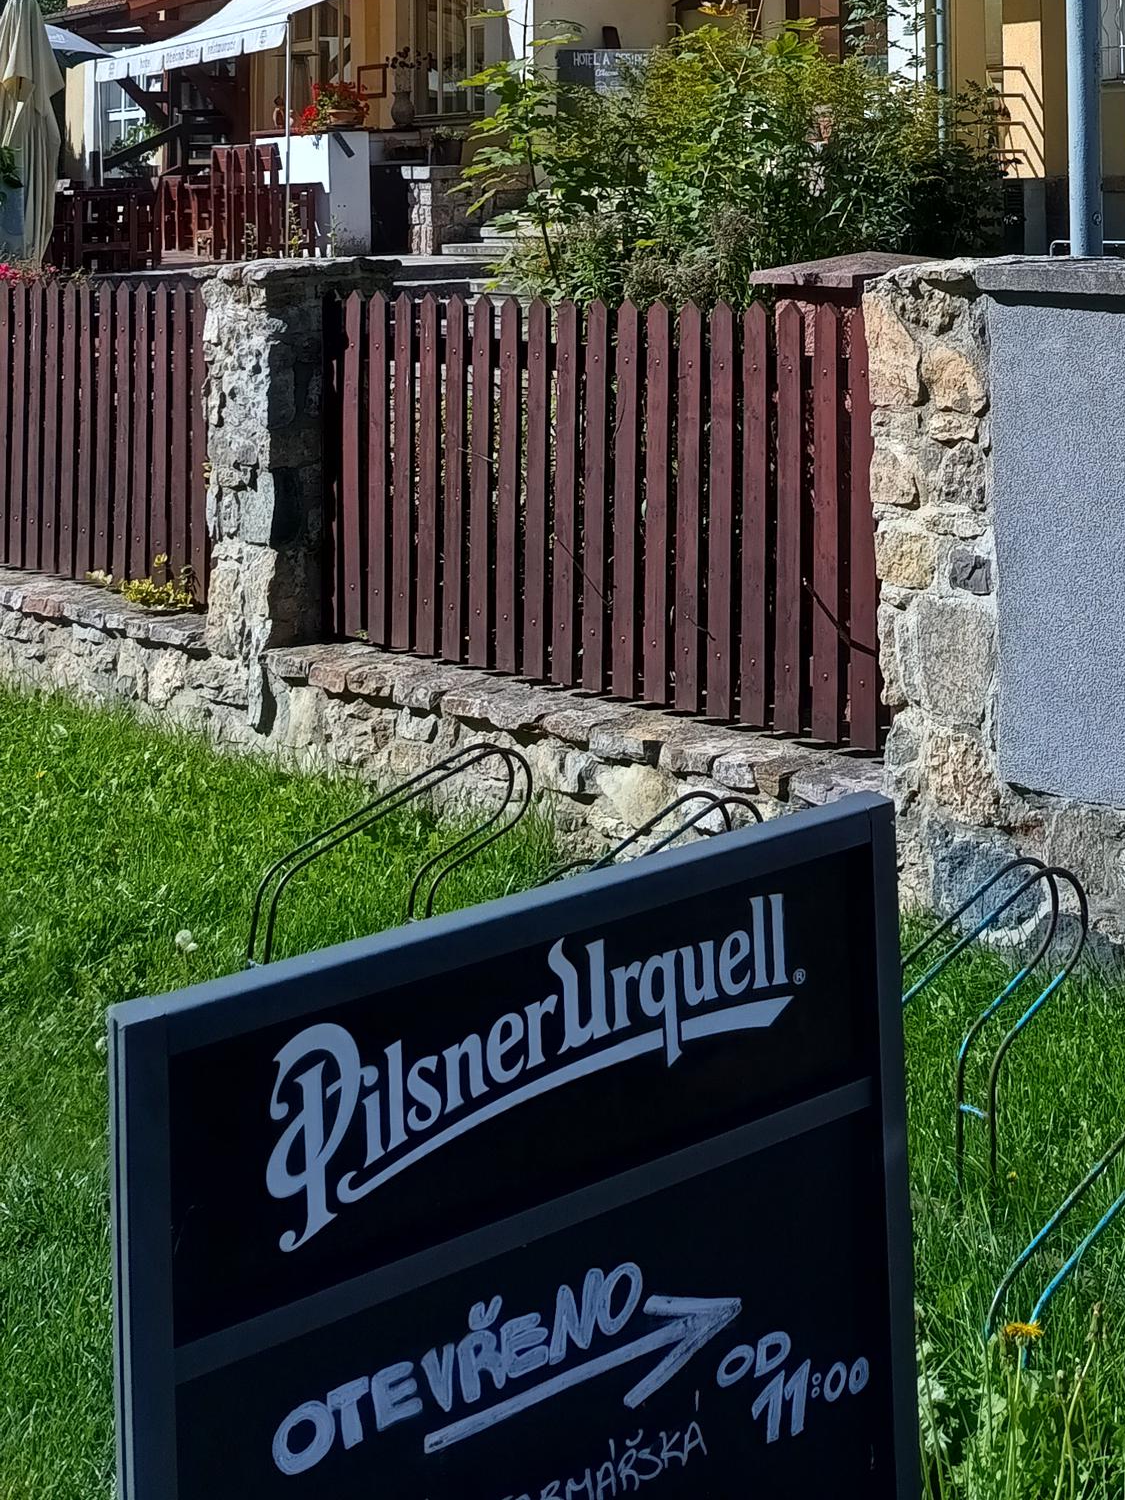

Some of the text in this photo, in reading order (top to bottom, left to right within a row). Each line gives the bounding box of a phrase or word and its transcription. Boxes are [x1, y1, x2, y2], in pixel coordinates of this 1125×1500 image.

[266, 893, 790, 1253] Pilsner Urquell
[271, 1261, 644, 1476] OTEVŘENO
[716, 1331, 791, 1388] OD
[751, 1357, 870, 1444] 11:00
